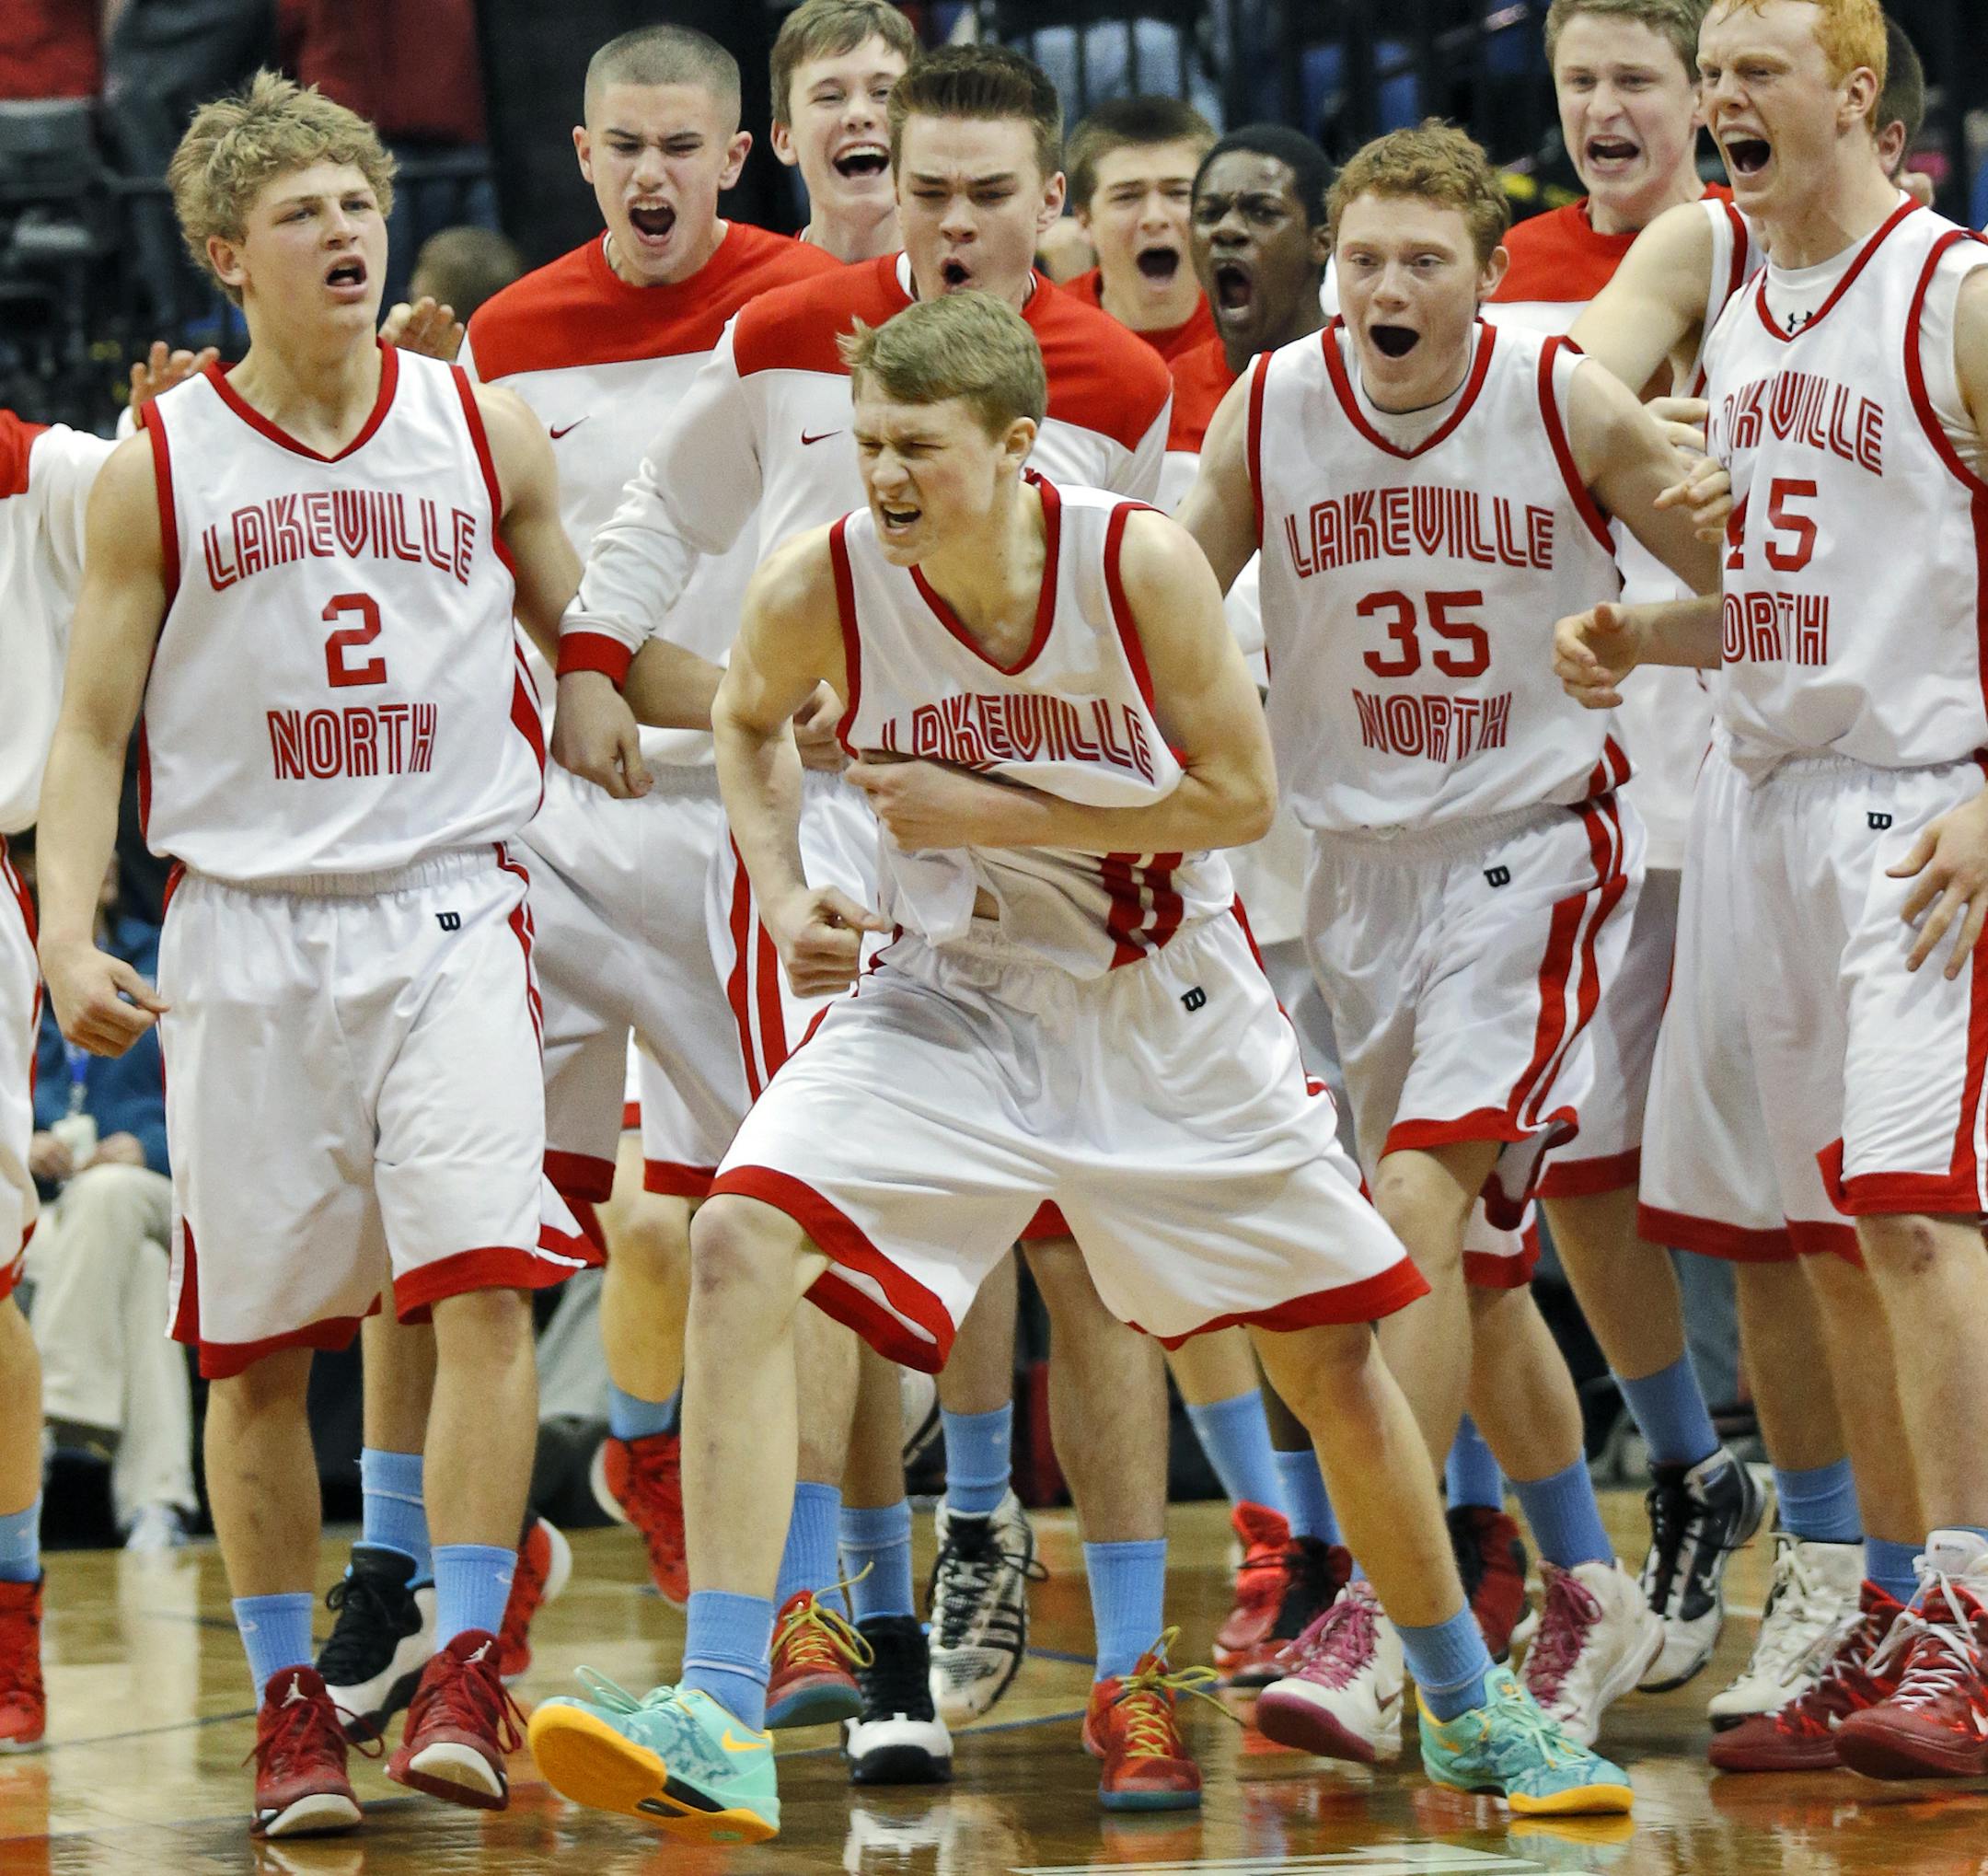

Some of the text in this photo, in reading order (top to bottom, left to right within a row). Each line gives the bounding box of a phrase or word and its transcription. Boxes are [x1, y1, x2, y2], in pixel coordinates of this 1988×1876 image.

[1713, 371, 1883, 477] KVILLE
[202, 490, 476, 591] LAKEVILLE
[1284, 486, 1554, 579] LAKEVILLE
[322, 592, 387, 688] 2
[1357, 589, 1490, 677] 35
[1722, 591, 1829, 666] ORTH
[267, 703, 437, 780] NORTH
[1352, 688, 1512, 764] NORTH
